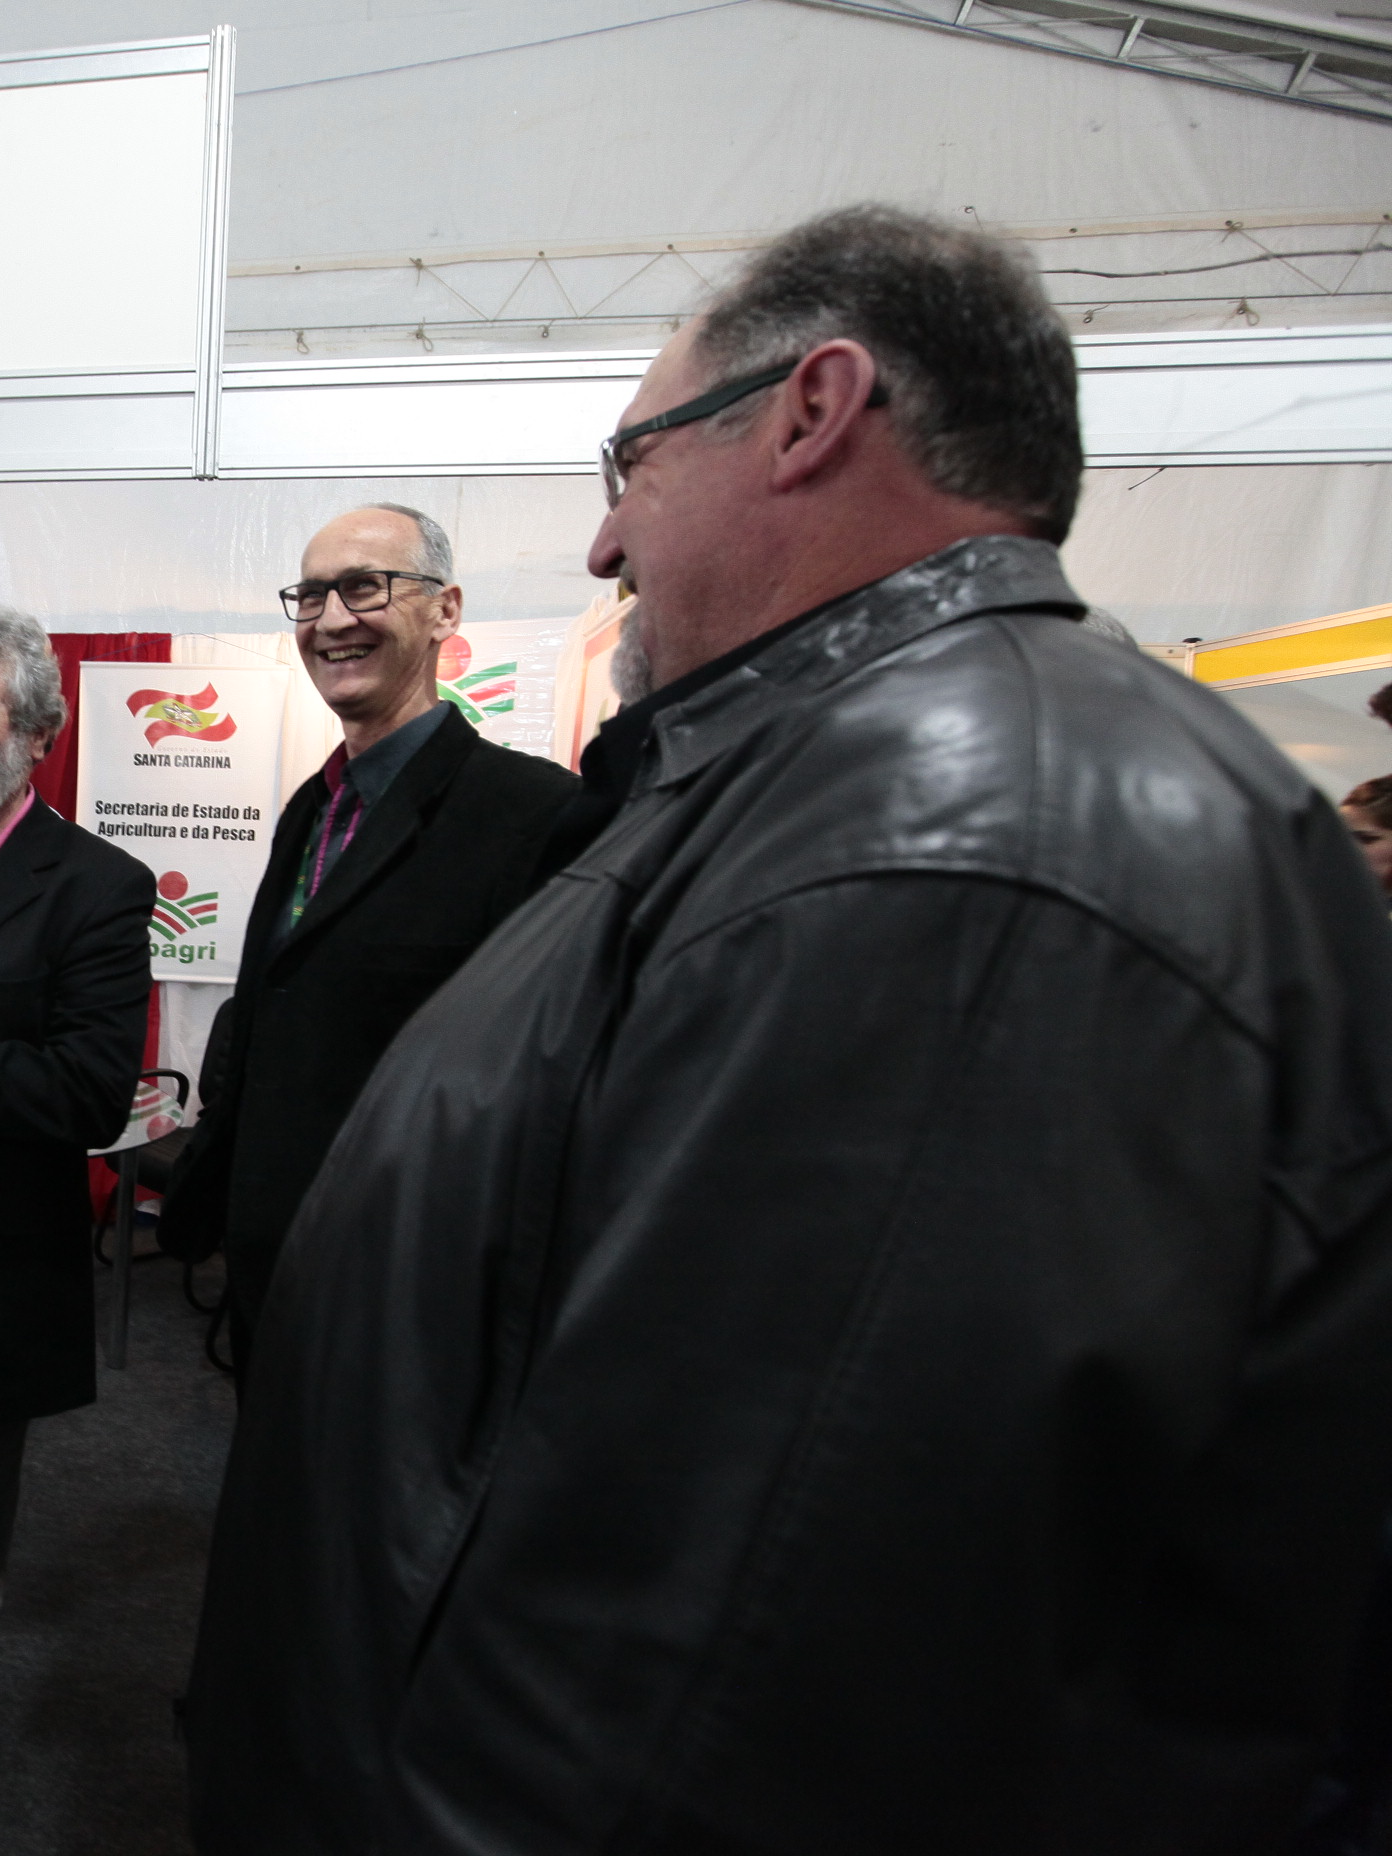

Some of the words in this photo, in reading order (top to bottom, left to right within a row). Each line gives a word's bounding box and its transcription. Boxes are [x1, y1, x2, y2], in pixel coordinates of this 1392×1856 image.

[133, 753, 171, 767] SANTA
[174, 755, 231, 769] CATARINA
[95, 800, 168, 817] Secretaria
[172, 803, 189, 818] de
[193, 804, 239, 820] Estado
[243, 806, 260, 821] da
[98, 821, 176, 838] Agricultura
[180, 827, 188, 838] e
[192, 825, 209, 839] da
[213, 826, 255, 841] Pesca
